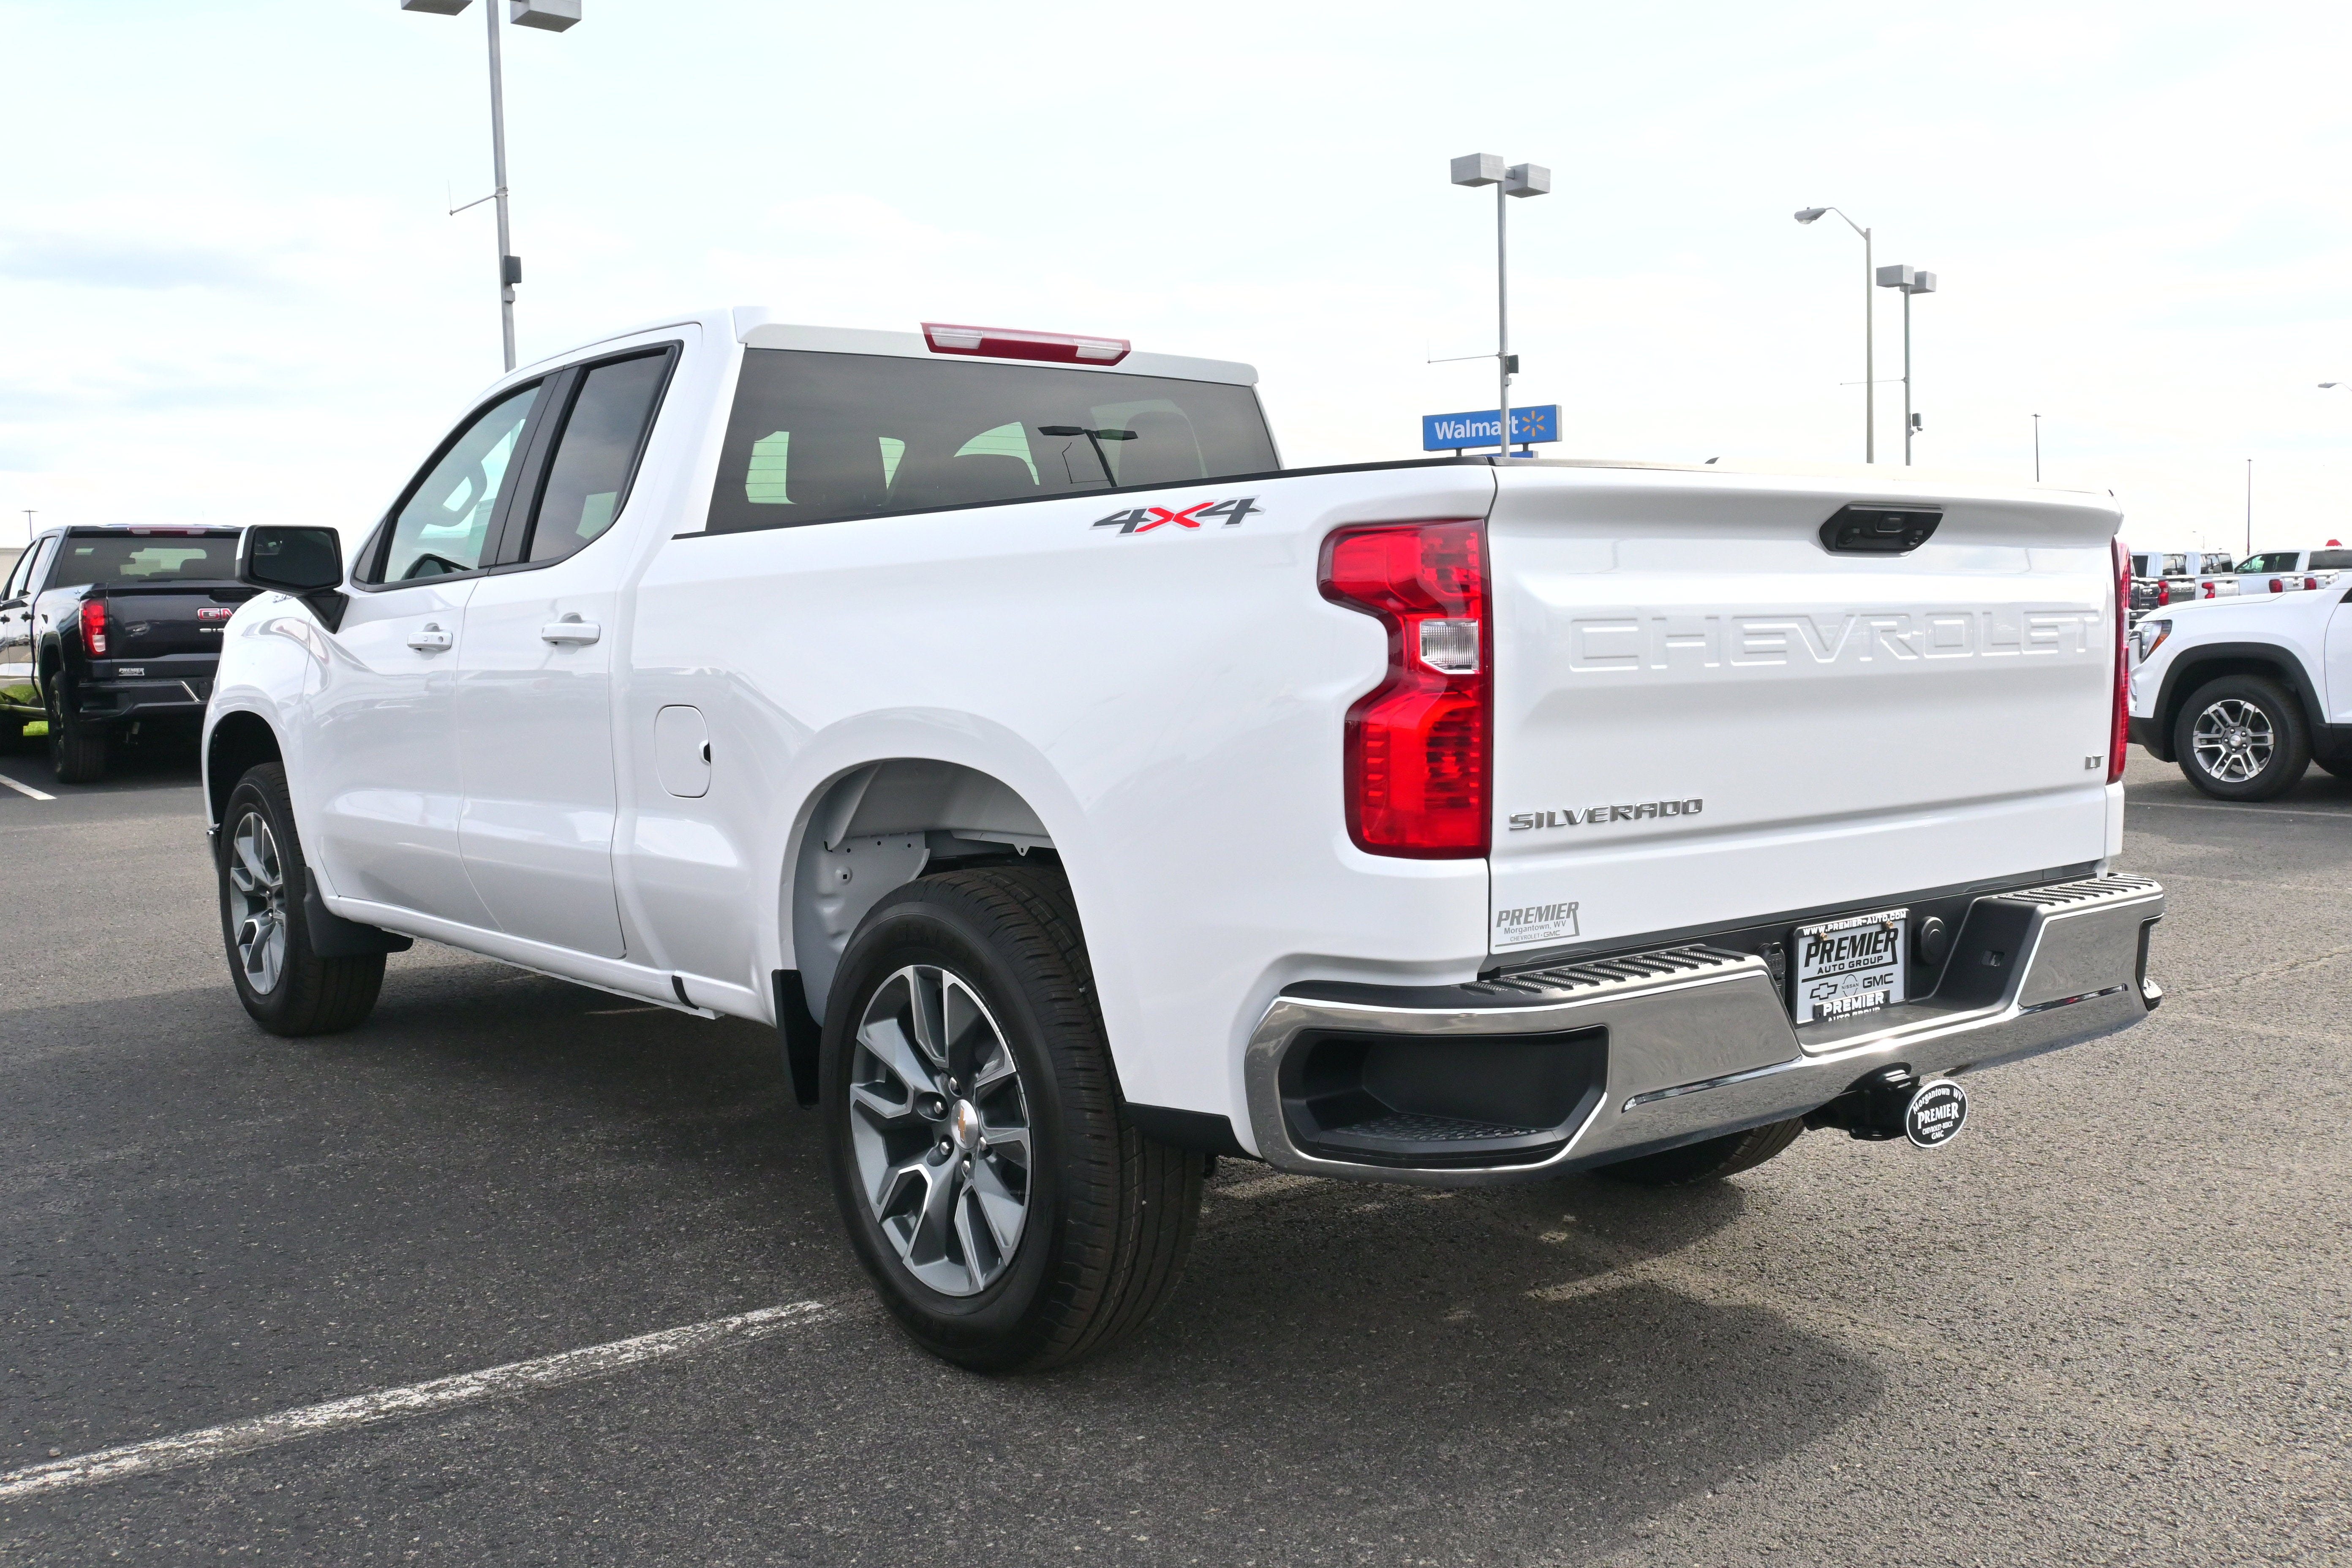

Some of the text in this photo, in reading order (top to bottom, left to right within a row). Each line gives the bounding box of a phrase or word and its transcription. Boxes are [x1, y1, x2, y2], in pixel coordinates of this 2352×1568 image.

[1435, 416, 1518, 440] Walmat
[197, 608, 233, 620] GM
[1570, 611, 2099, 672] CHEVROLET
[2085, 754, 2104, 770] LT
[1509, 798, 1703, 831] SILVERADO
[1496, 901, 1580, 928] PREMIER
[1554, 920, 1566, 928] WV
[1803, 912, 1906, 936] WWW.PREMIER-AUTO.COM
[1510, 933, 1540, 942] CHEVROLET
[1804, 928, 1899, 968] PREMIER
[1818, 956, 1883, 974] AUTO GROUP
[1863, 973, 1893, 988] GMC
[1823, 992, 1884, 1017] PREMIER
[1913, 1088, 1963, 1115] Morgantown WV
[1917, 1102, 1959, 1130] PREMIER
[1931, 1130, 1944, 1140] GMC
